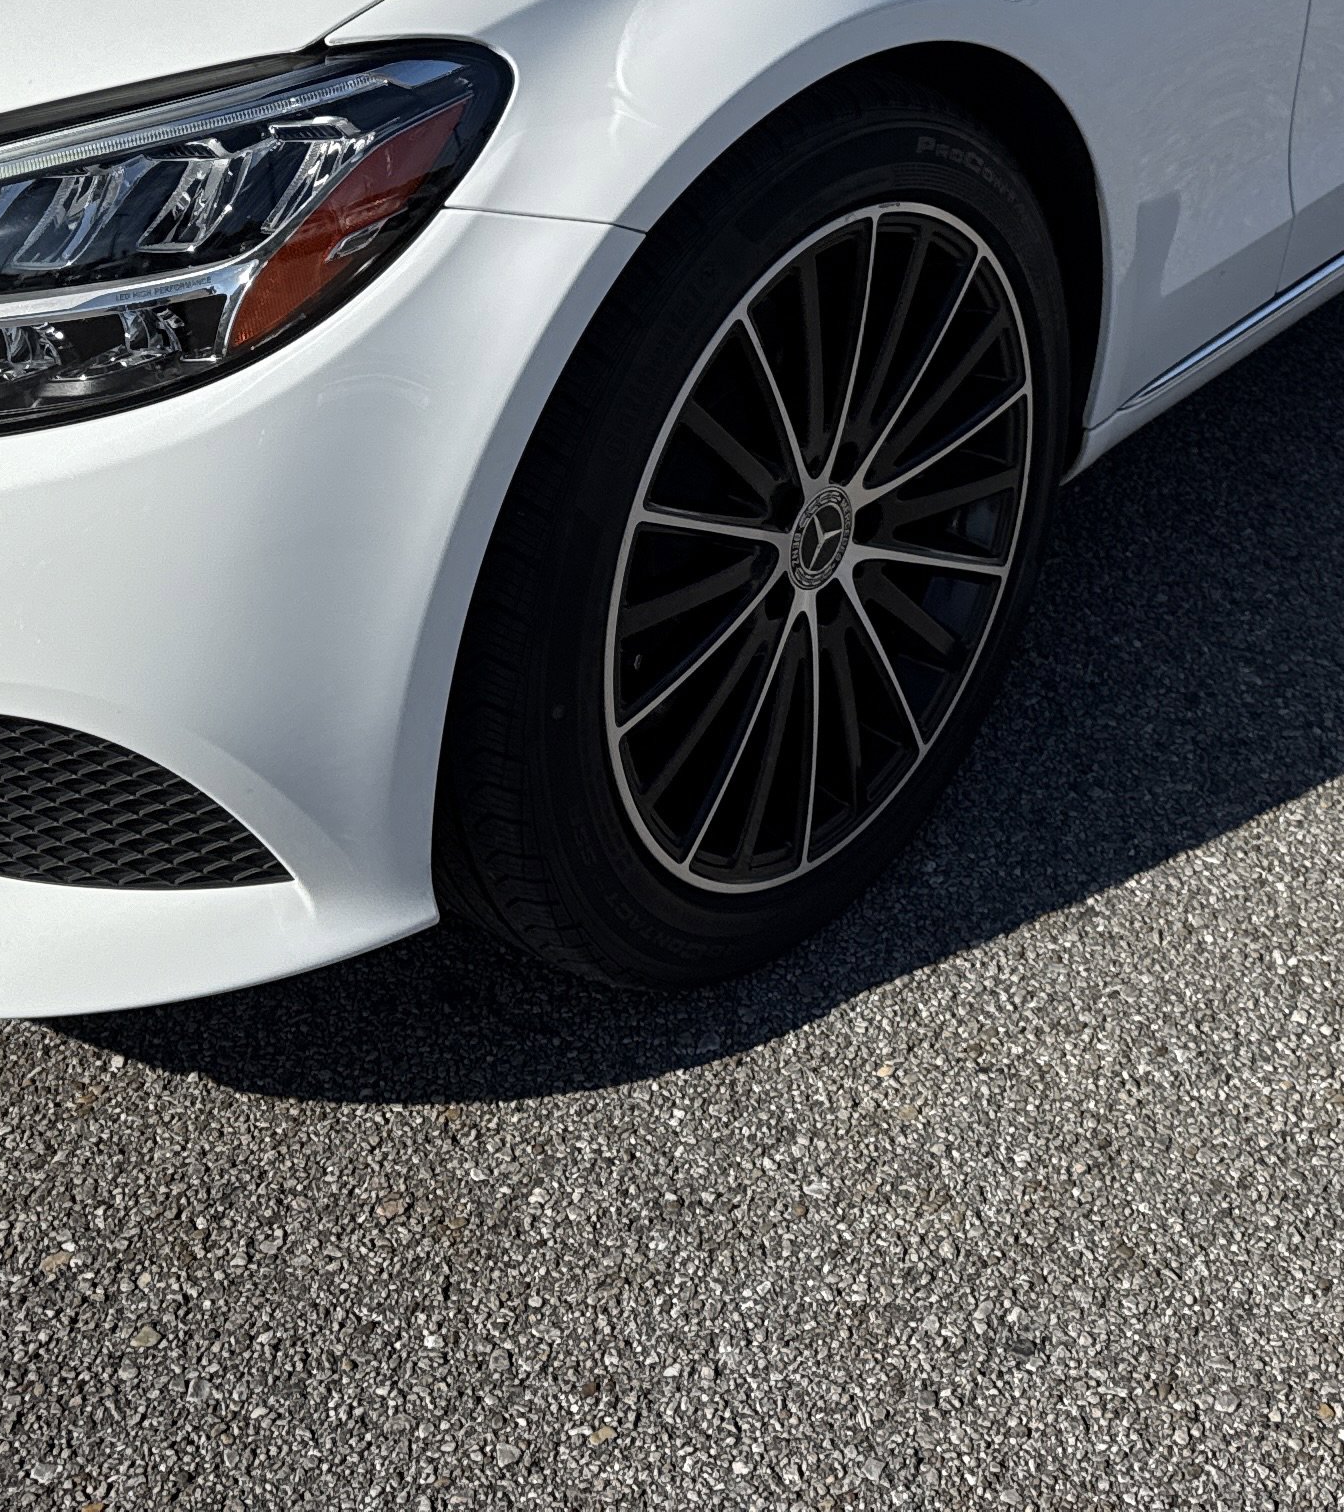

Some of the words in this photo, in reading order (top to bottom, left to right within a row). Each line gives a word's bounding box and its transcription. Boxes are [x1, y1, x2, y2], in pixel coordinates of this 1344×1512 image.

[115, 294, 131, 302] LED
[132, 291, 152, 299] HIGH
[154, 276, 212, 295] PERFORMANCE
[790, 532, 802, 568] BENZ
